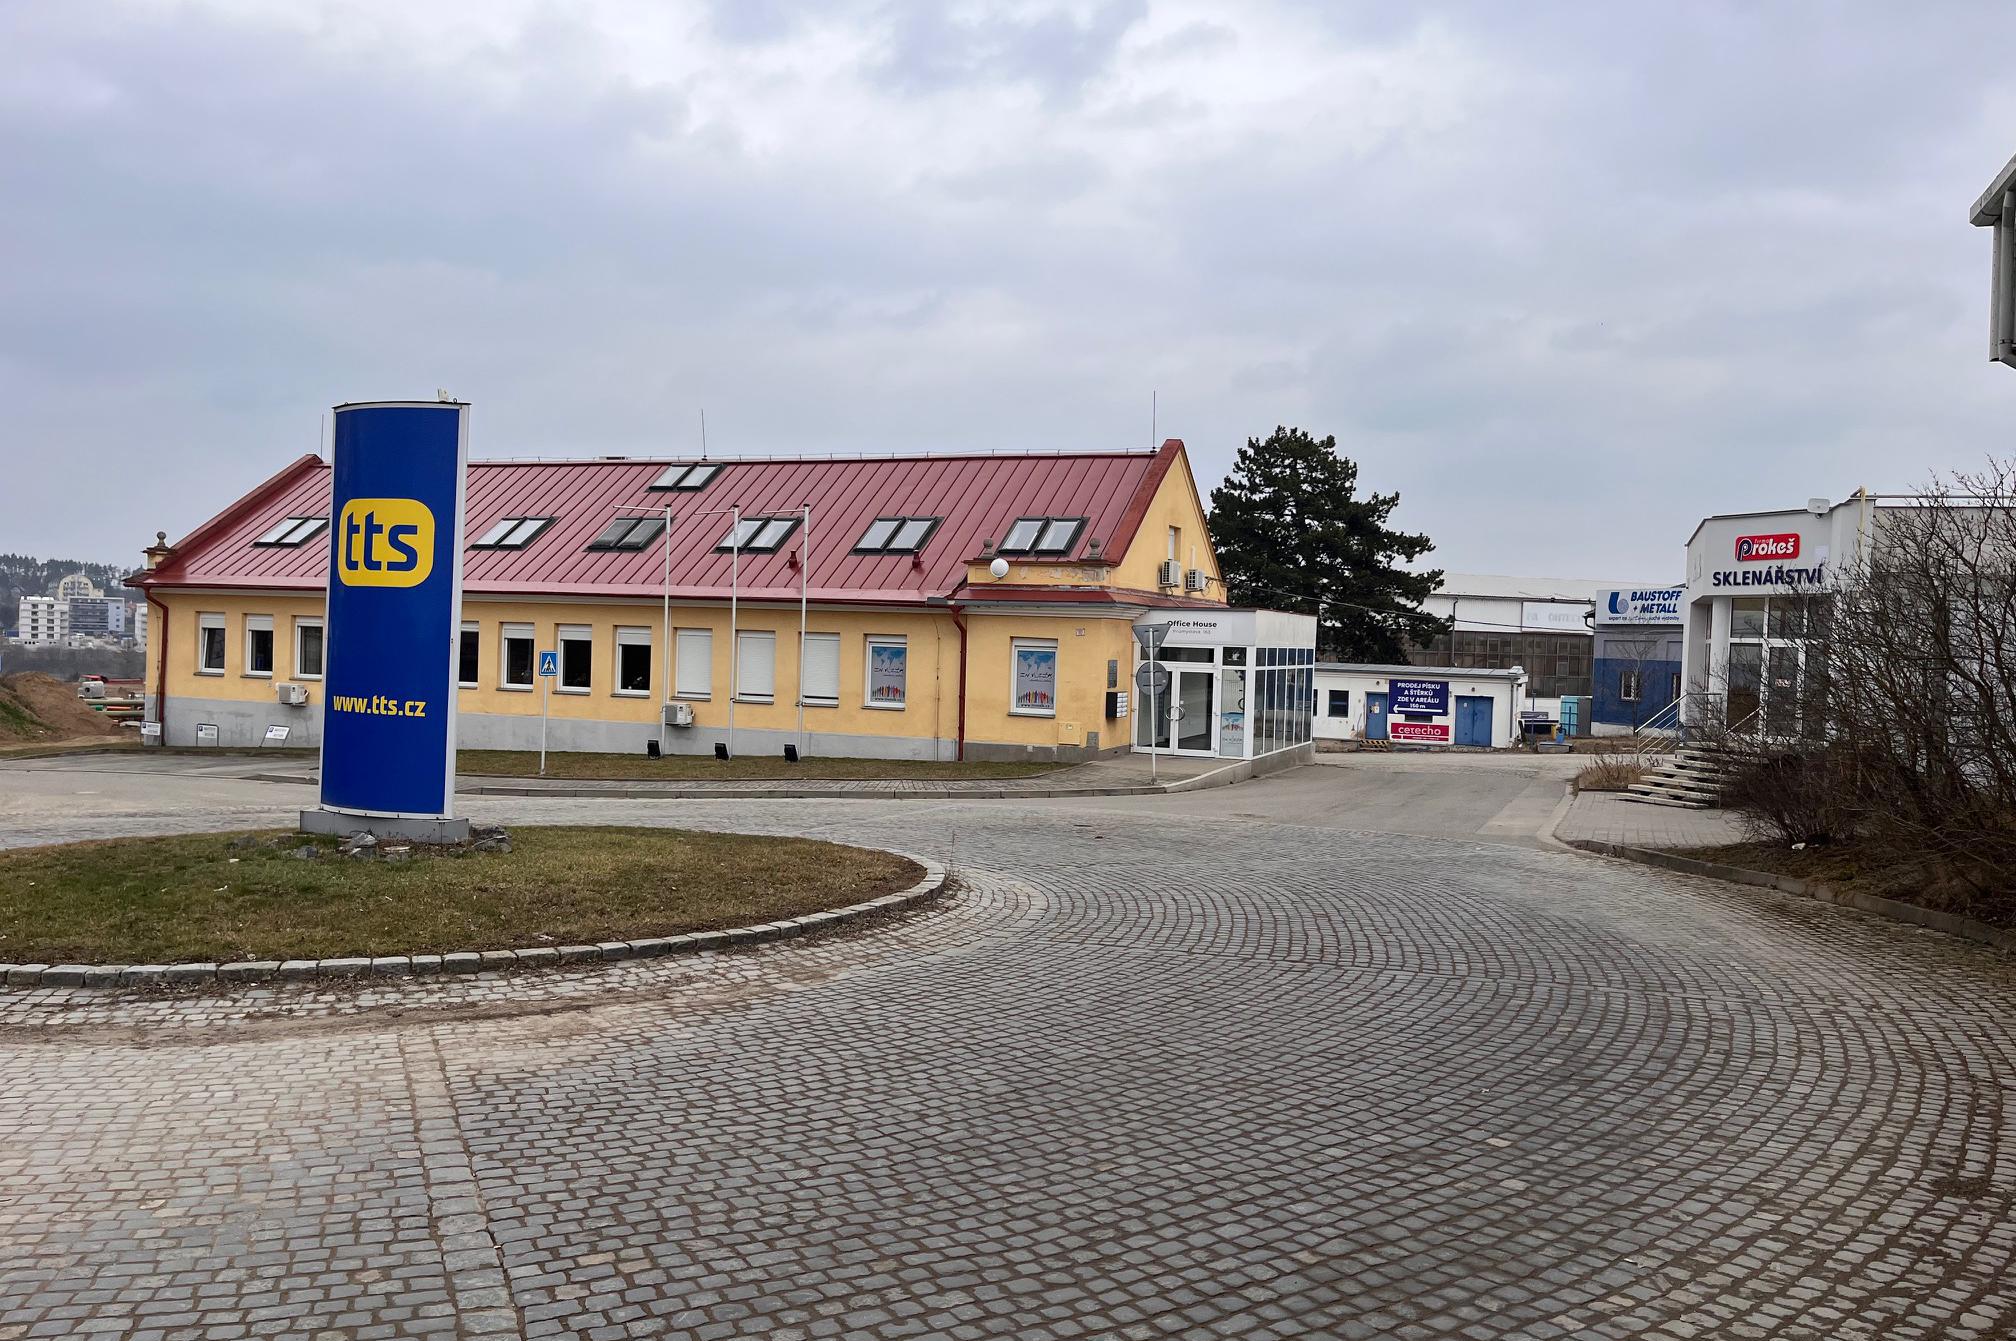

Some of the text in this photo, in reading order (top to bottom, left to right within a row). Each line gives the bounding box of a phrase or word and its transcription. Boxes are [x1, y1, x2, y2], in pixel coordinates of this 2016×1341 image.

[345, 511, 418, 571] tts
[1712, 563, 1824, 587] SKLENÁŘSTVÍ
[1631, 590, 1682, 601] BAUSTOFF
[1640, 603, 1677, 613] METALL
[1422, 682, 1441, 690] PÍSKU
[333, 695, 427, 717] www.tts.cz
